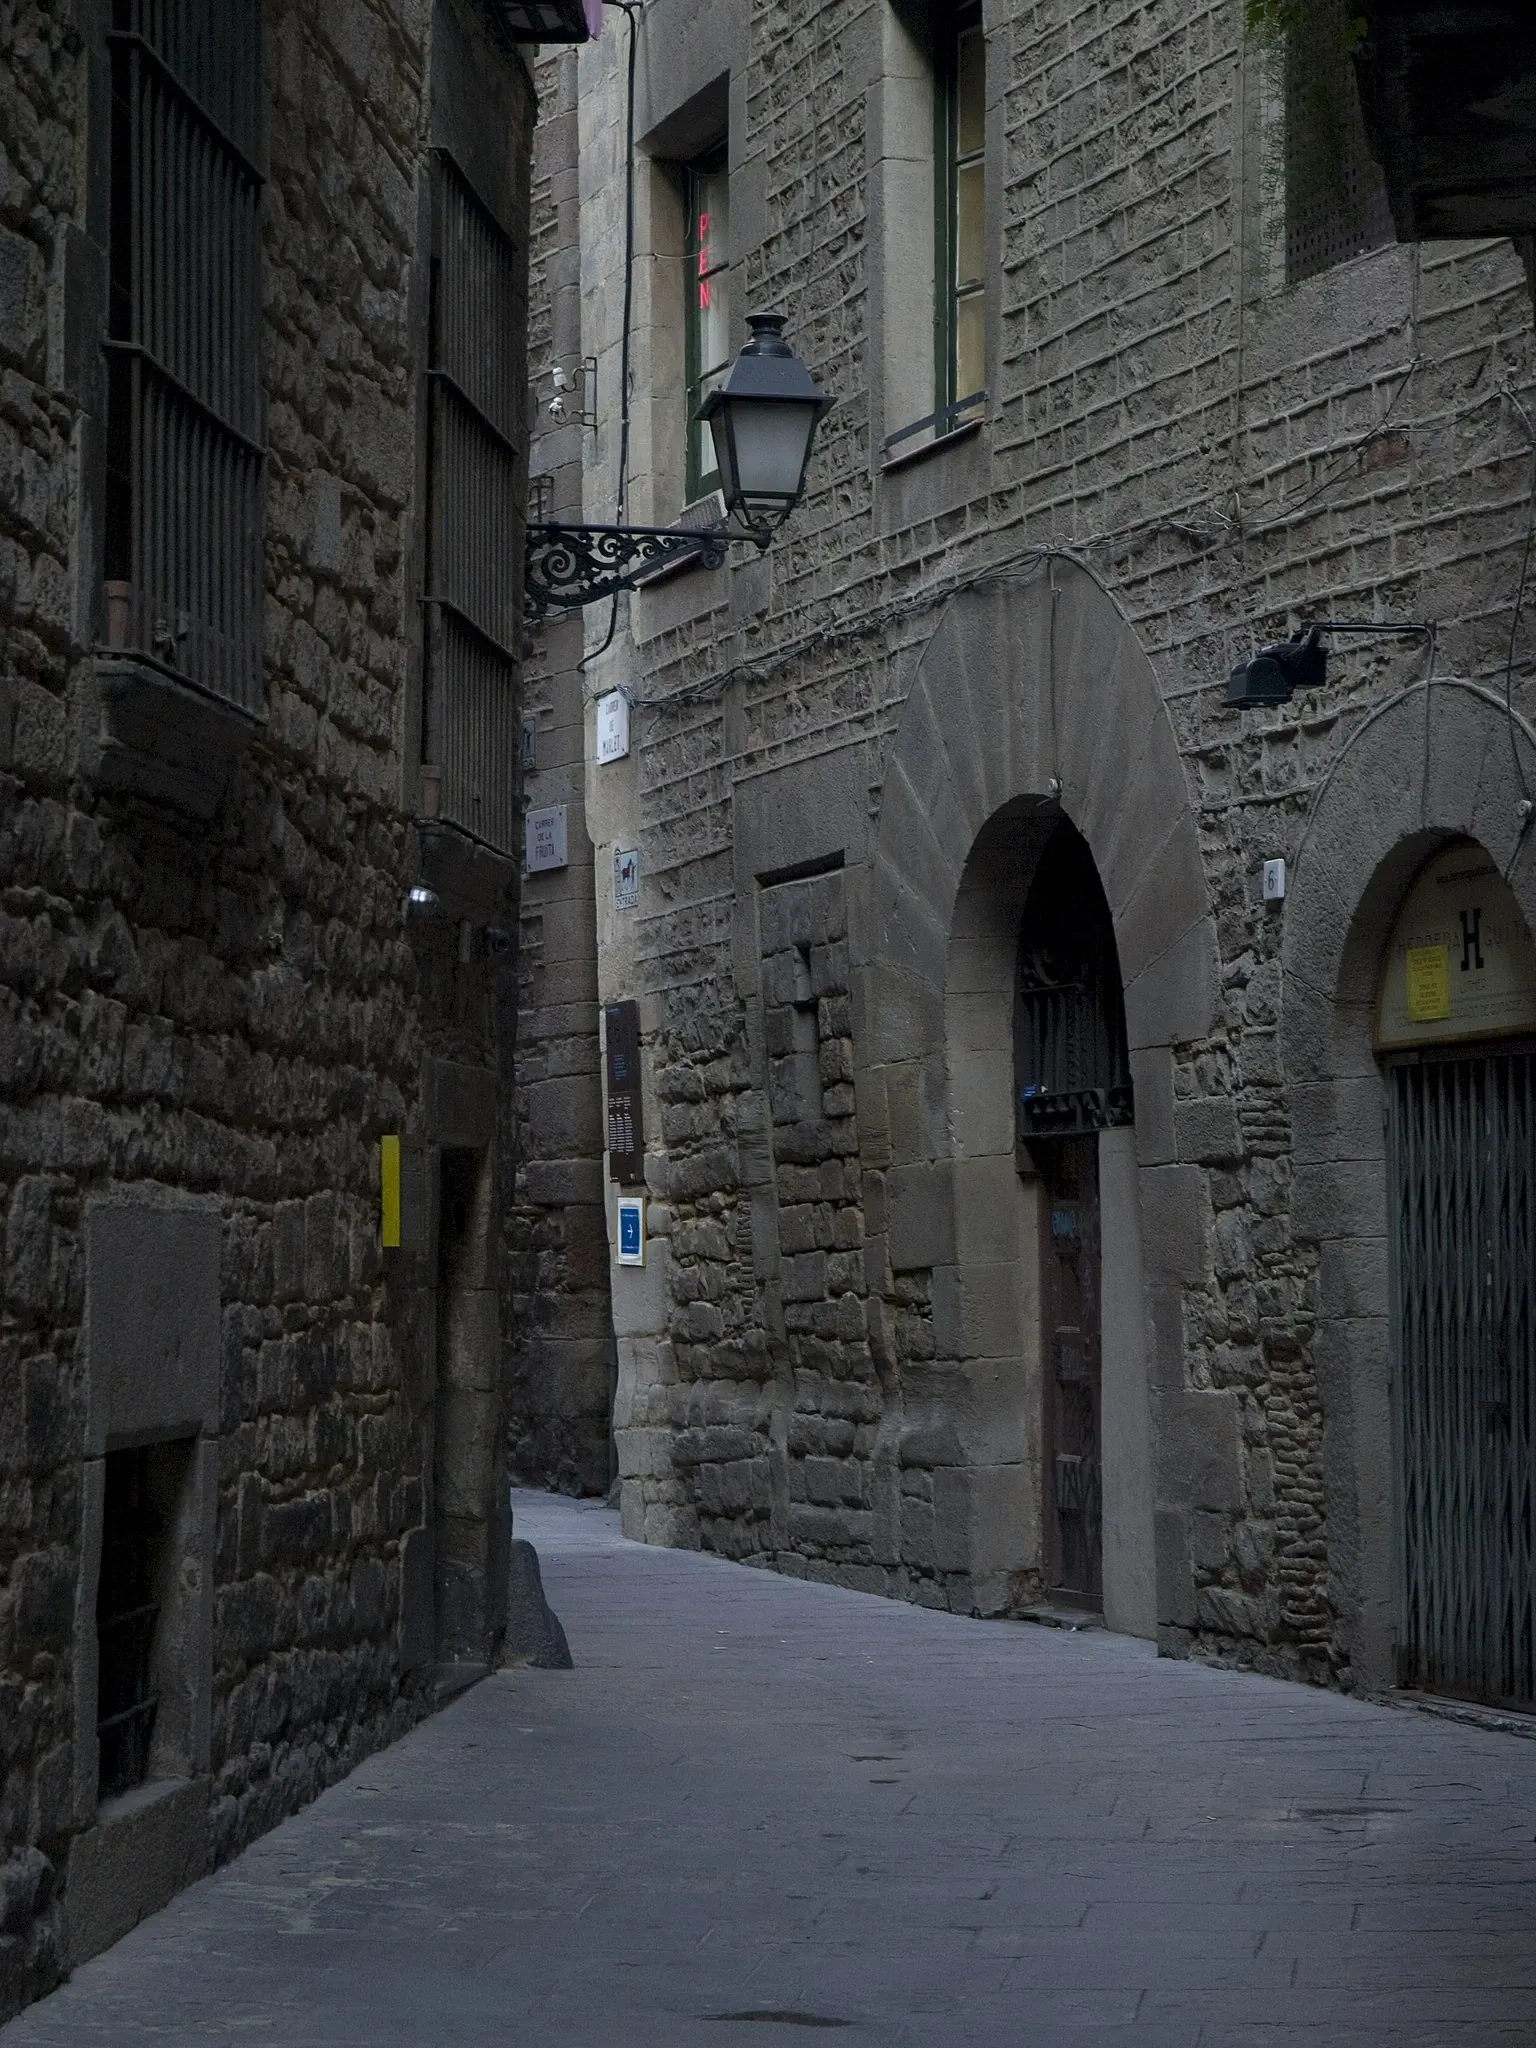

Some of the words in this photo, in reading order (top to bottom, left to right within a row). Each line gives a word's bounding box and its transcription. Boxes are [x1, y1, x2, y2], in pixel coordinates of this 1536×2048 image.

[535, 817, 554, 830] CARRER
[535, 843, 555, 860] FRUITA
[1268, 870, 1275, 891] 6
[616, 893, 637, 909] ENTRADA
[1459, 907, 1485, 973] H
